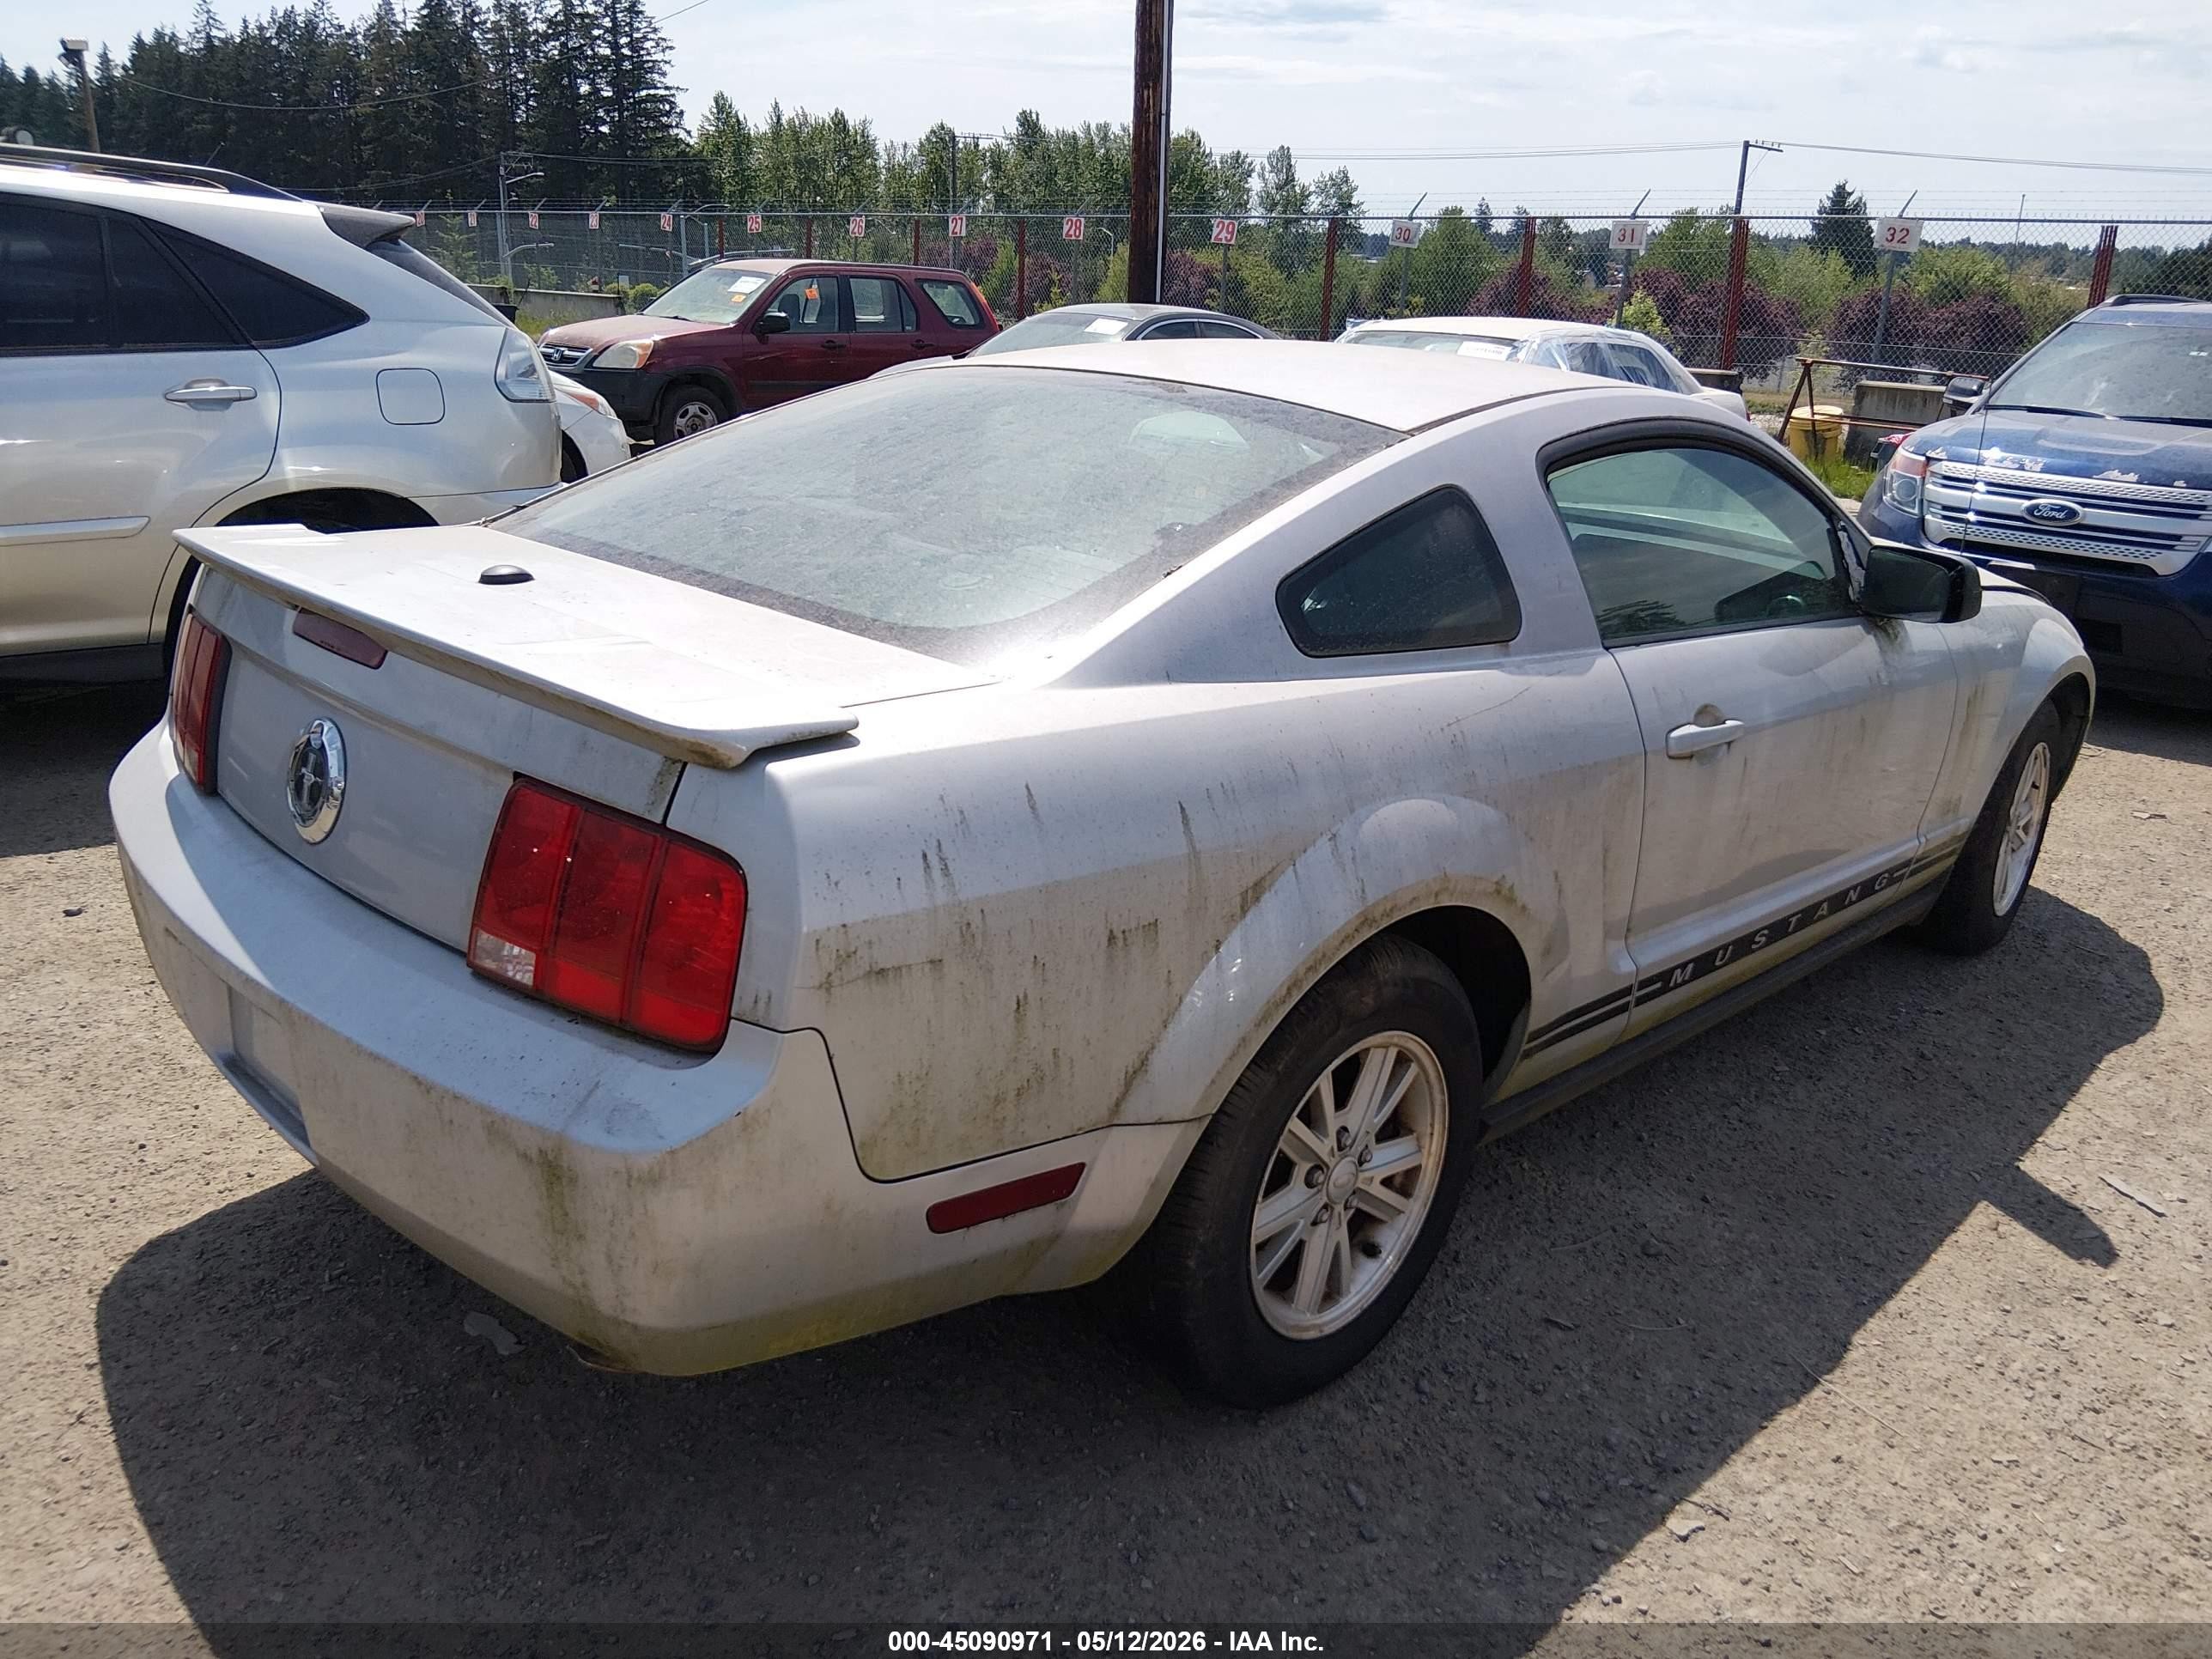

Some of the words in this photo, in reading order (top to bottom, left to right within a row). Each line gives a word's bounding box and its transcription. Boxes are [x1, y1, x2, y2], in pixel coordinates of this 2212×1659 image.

[530, 214, 538, 228] 22
[590, 214, 599, 228] 23
[662, 215, 672, 230] 24
[748, 216, 761, 231] 25
[851, 218, 864, 235] 26
[951, 217, 963, 235] 27
[1065, 218, 1082, 239] 28
[1213, 220, 1237, 242] 29
[1395, 227, 1411, 242] 30
[1618, 228, 1635, 243] 31
[1886, 227, 1910, 244] 32
[2033, 503, 2068, 519] Ford
[1668, 872, 1889, 988] MUSTANG
